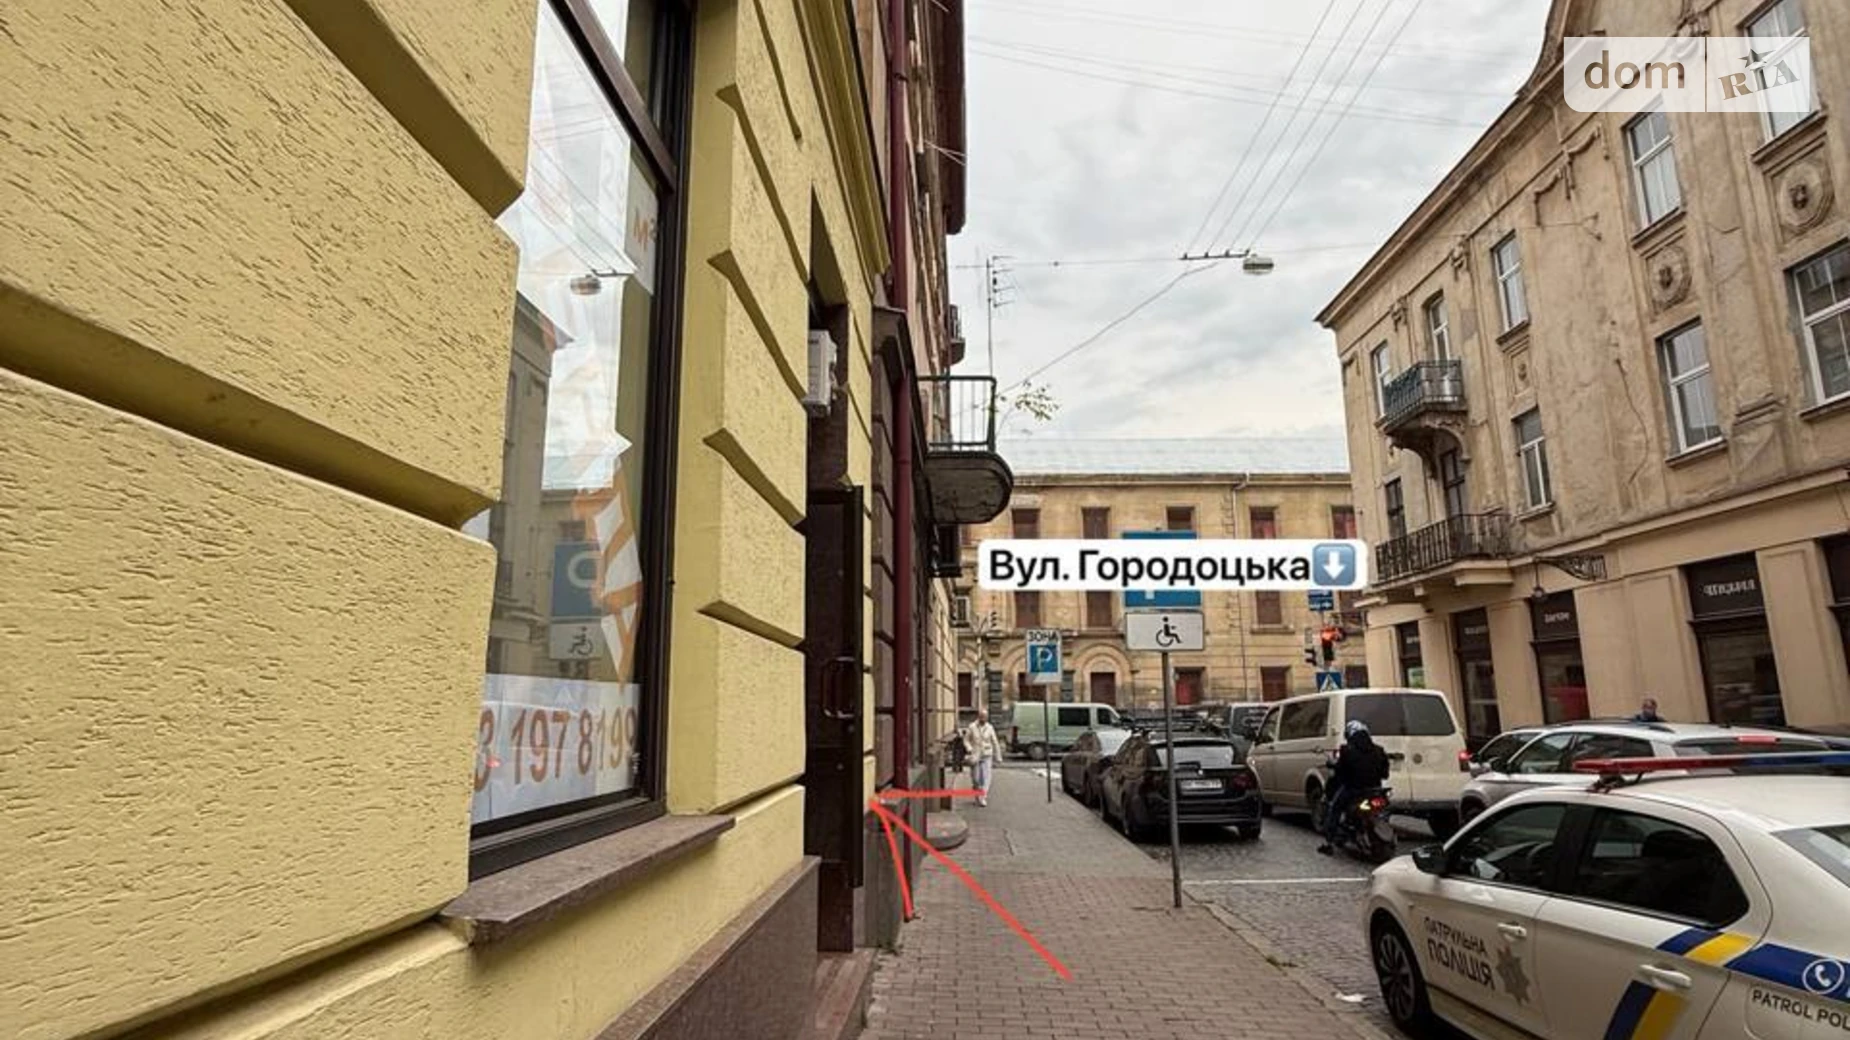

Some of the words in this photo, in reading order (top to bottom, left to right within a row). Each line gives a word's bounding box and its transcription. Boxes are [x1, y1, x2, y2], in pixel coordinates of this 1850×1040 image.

[1029, 631, 1058, 641] ЗОНА
[511, 708, 571, 785] 197
[1424, 916, 1488, 957] ПАТРУЛЬНА
[1427, 938, 1496, 991] ПОЛІЦІЯ
[1752, 990, 1812, 1019] PATROL
